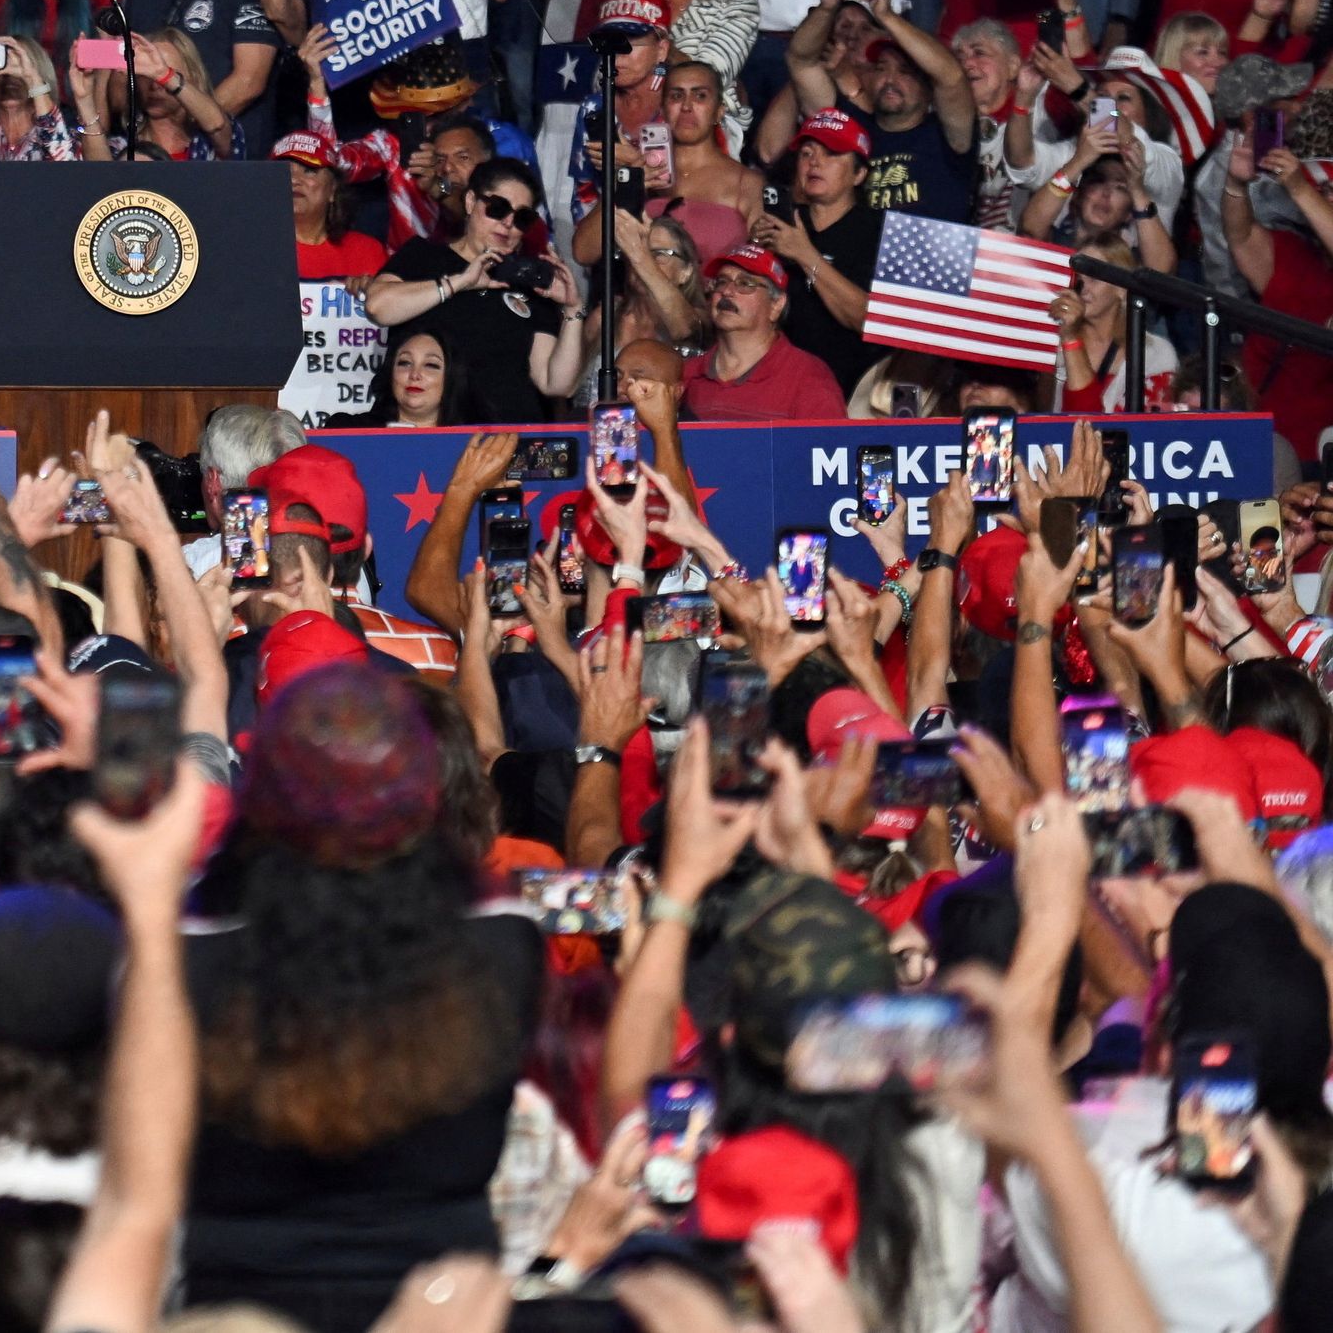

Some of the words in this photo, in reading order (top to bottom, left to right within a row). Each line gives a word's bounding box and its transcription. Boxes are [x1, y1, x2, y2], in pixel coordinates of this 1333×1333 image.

[808, 121, 844, 131] TRUMP
[290, 134, 322, 147] AMERICA
[295, 143, 317, 154] AGAIN
[138, 195, 149, 205] OF
[152, 199, 167, 212] THE
[79, 195, 134, 248] PRESIDENT
[169, 211, 194, 261] UNITED
[81, 252, 91, 270] THE
[85, 271, 94, 282] OF
[93, 281, 125, 308] SEAL
[146, 272, 189, 309] STATES
[812, 443, 965, 486] MKE
[1262, 789, 1308, 807] TRUMP
